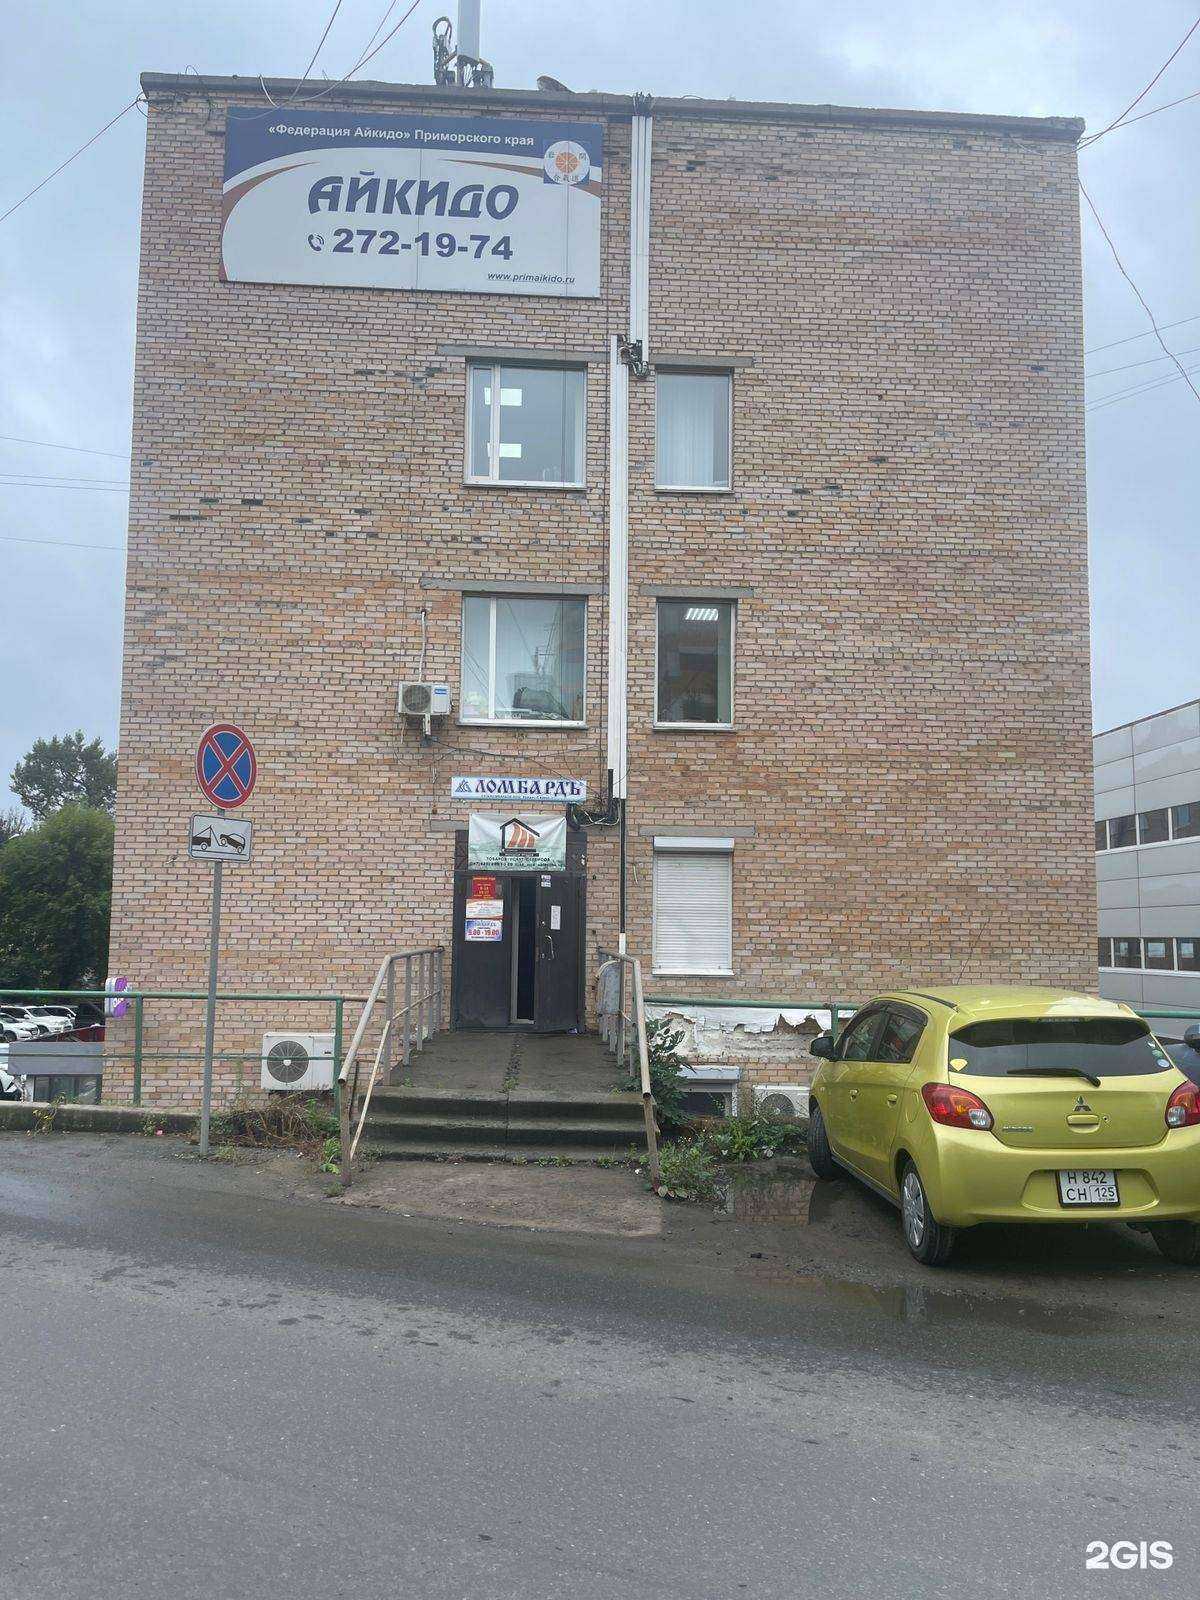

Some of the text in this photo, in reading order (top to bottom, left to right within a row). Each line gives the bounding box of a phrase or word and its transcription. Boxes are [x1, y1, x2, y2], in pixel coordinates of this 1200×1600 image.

[268, 124, 535, 146] «Федерация Айкидо» Приморского края
[307, 170, 520, 220] АЙКИДО
[332, 228, 514, 260] 272-19-74
[487, 272, 576, 284] www.primaikido.ru
[475, 779, 581, 797] ЛОМБАРДЪ
[1082, 1171, 1107, 1184] 842
[1095, 1187, 1115, 1198] 125
